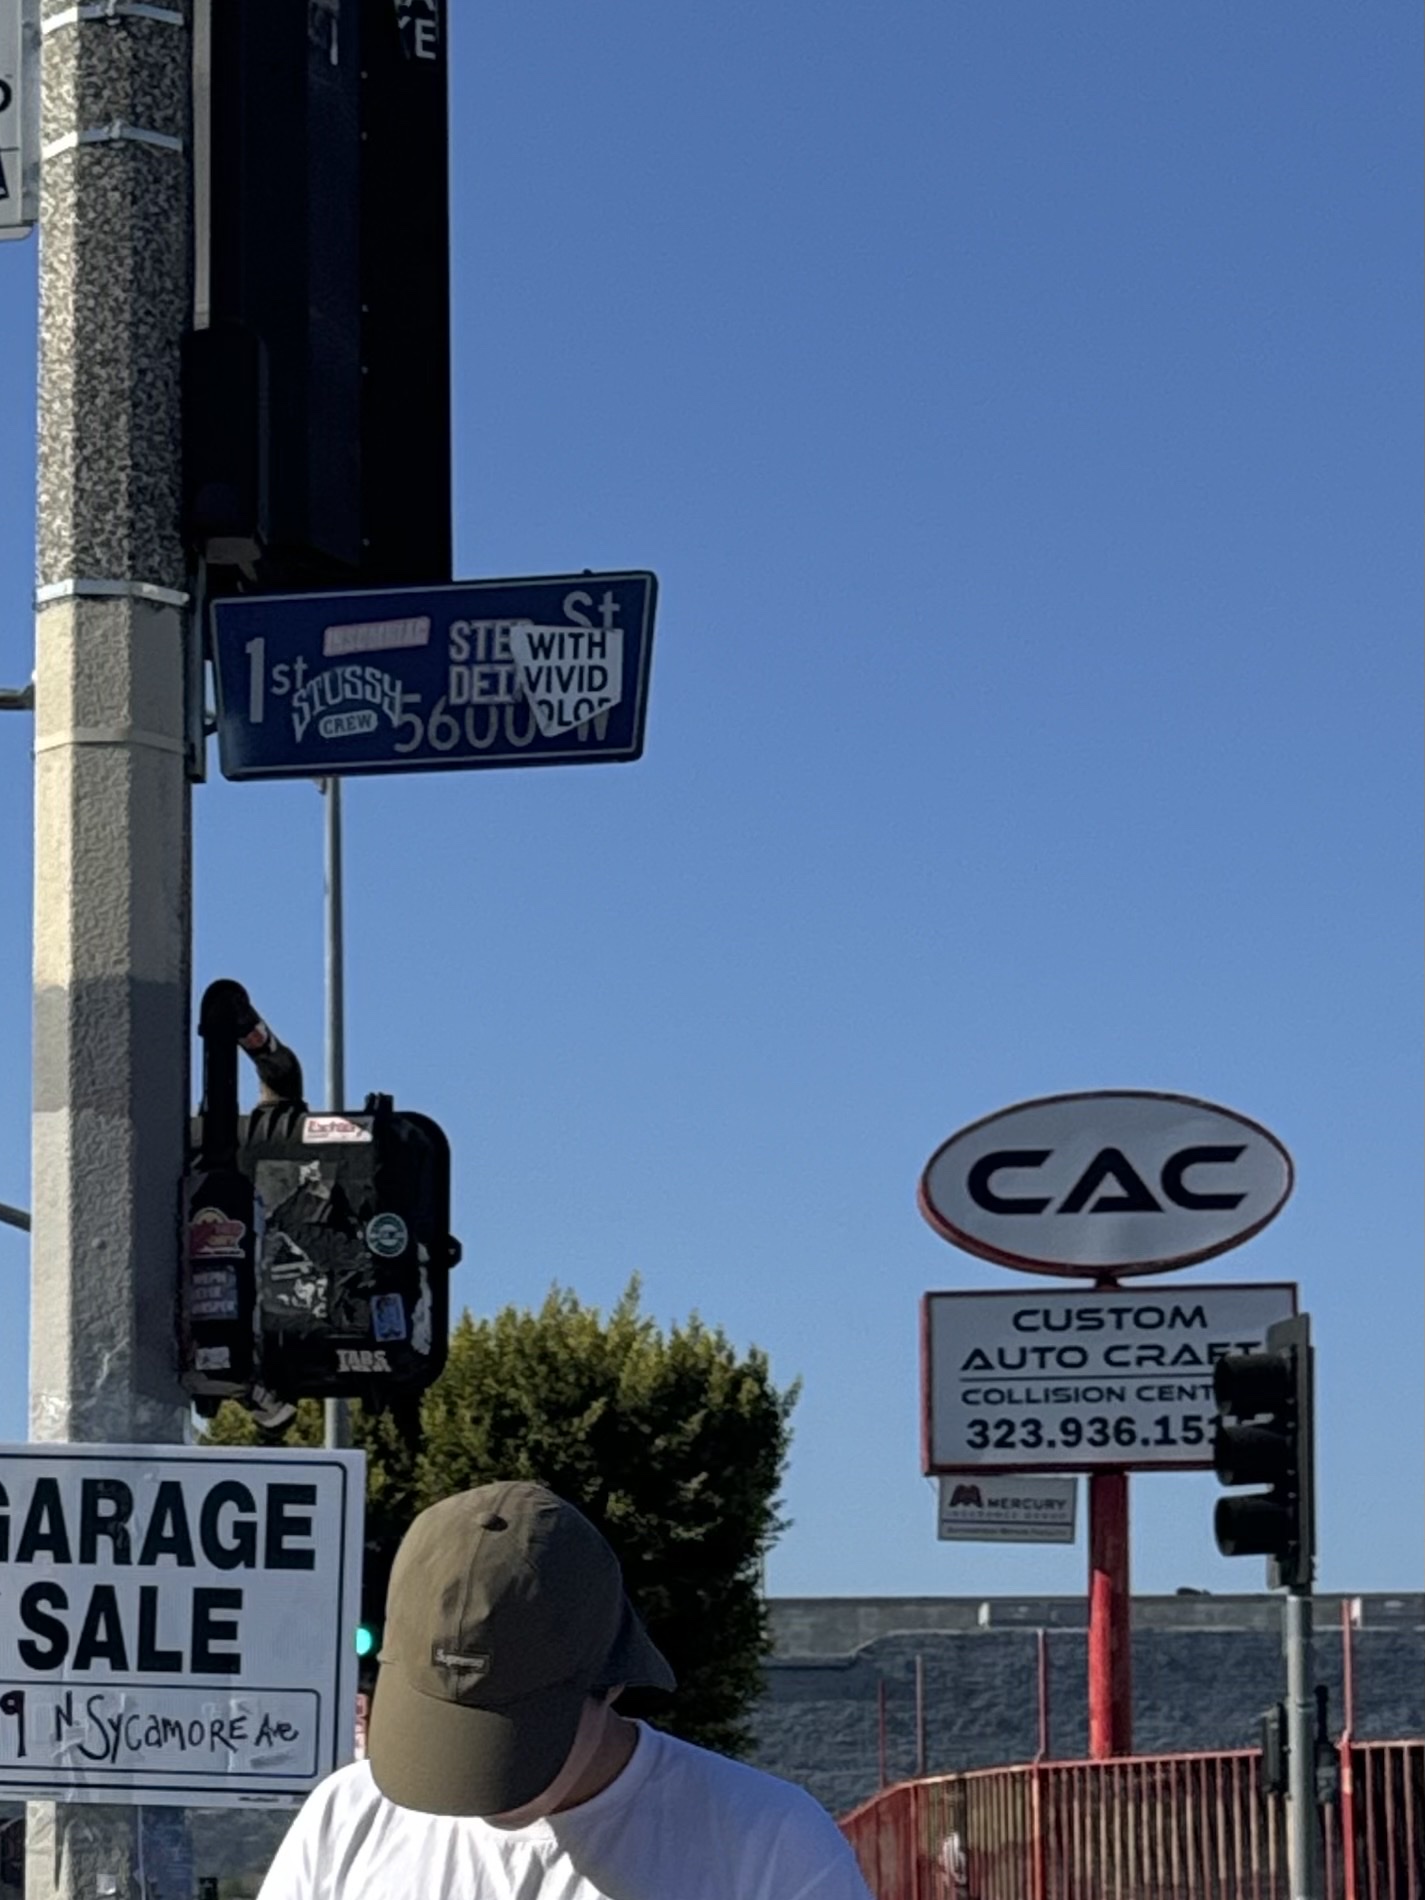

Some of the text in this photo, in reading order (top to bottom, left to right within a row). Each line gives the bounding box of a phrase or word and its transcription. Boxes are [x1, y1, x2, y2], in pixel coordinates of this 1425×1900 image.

[527, 632, 607, 660] WITH
[245, 637, 308, 724] 1st
[523, 664, 608, 694] VIVID
[292, 664, 403, 743] STUSSY
[323, 712, 372, 735] CREW
[967, 1144, 1250, 1216] CAC
[1012, 1305, 1209, 1333] CUSTOM
[960, 1345, 1088, 1371] AUTO
[960, 1386, 1127, 1406] COLLISION
[987, 1497, 1067, 1511] MERCURY
[17, 1581, 244, 1675] SALE
[54, 1690, 74, 1742] N
